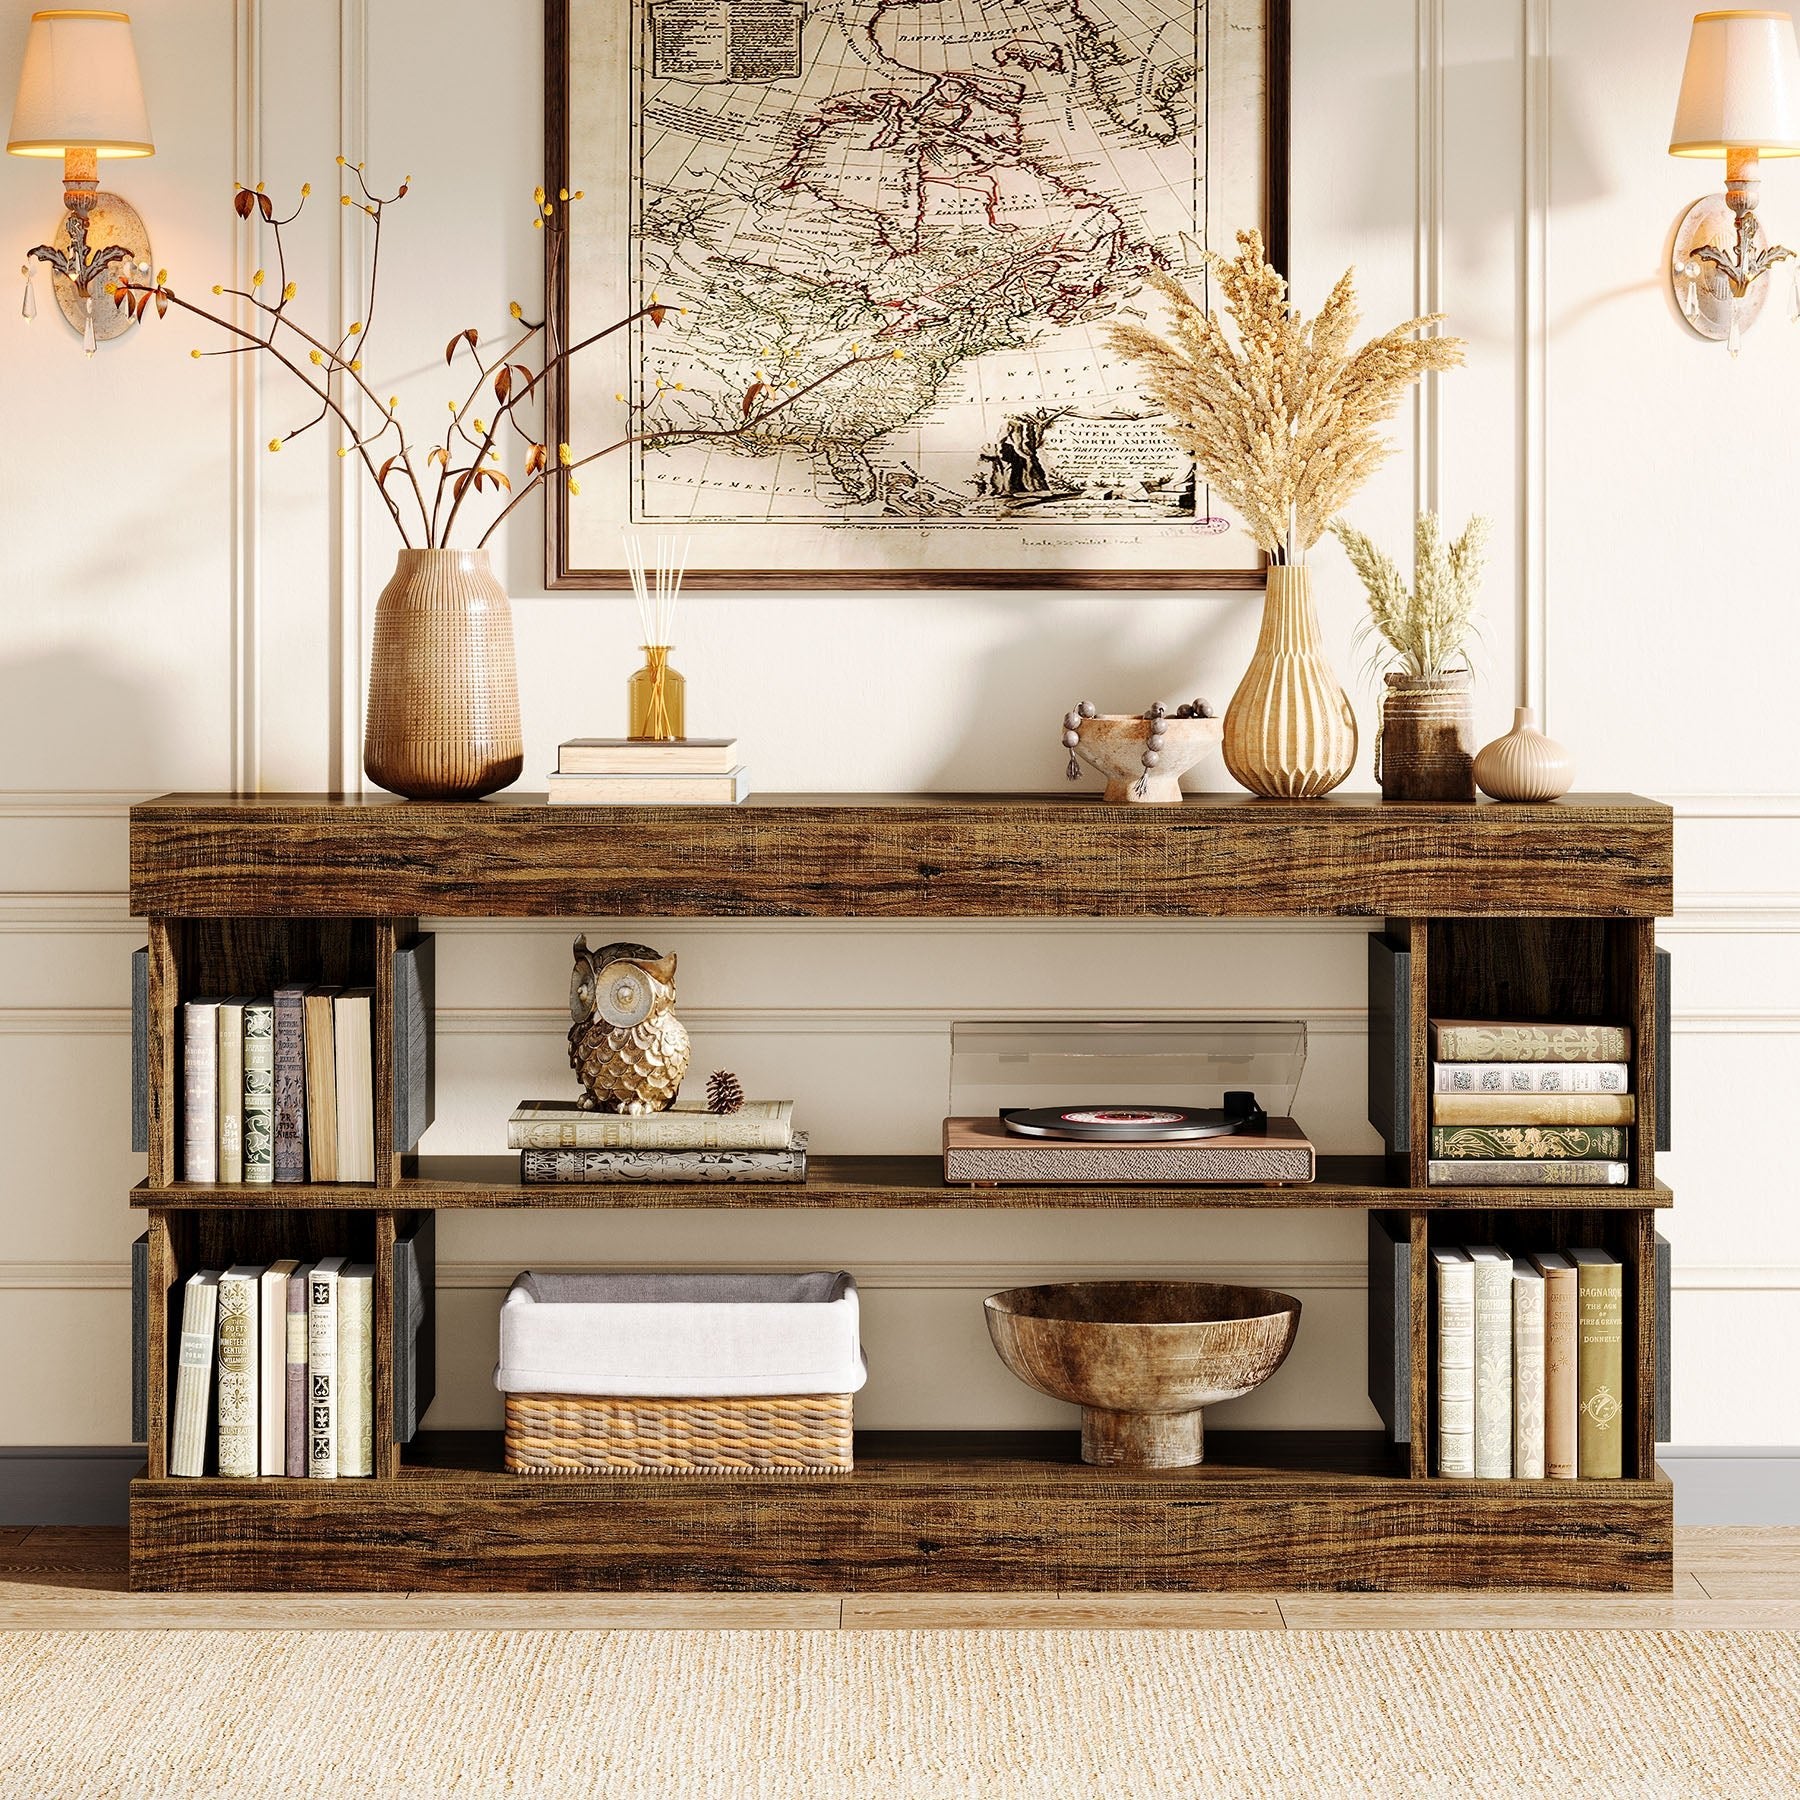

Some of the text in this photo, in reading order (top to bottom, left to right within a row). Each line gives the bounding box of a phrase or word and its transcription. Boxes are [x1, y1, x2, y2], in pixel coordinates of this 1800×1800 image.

[800, 170, 872, 183] HUDSONS
[1008, 362, 1129, 377] WESTERN
[967, 389, 1094, 403] ATLANTIC
[1059, 429, 1109, 438] UNITED
[1072, 437, 1117, 445] NORTH
[657, 474, 709, 485] GULF
[730, 481, 812, 493] MEXICO
[562, 1126, 574, 1145] HOW
[606, 1126, 618, 1145] WHY
